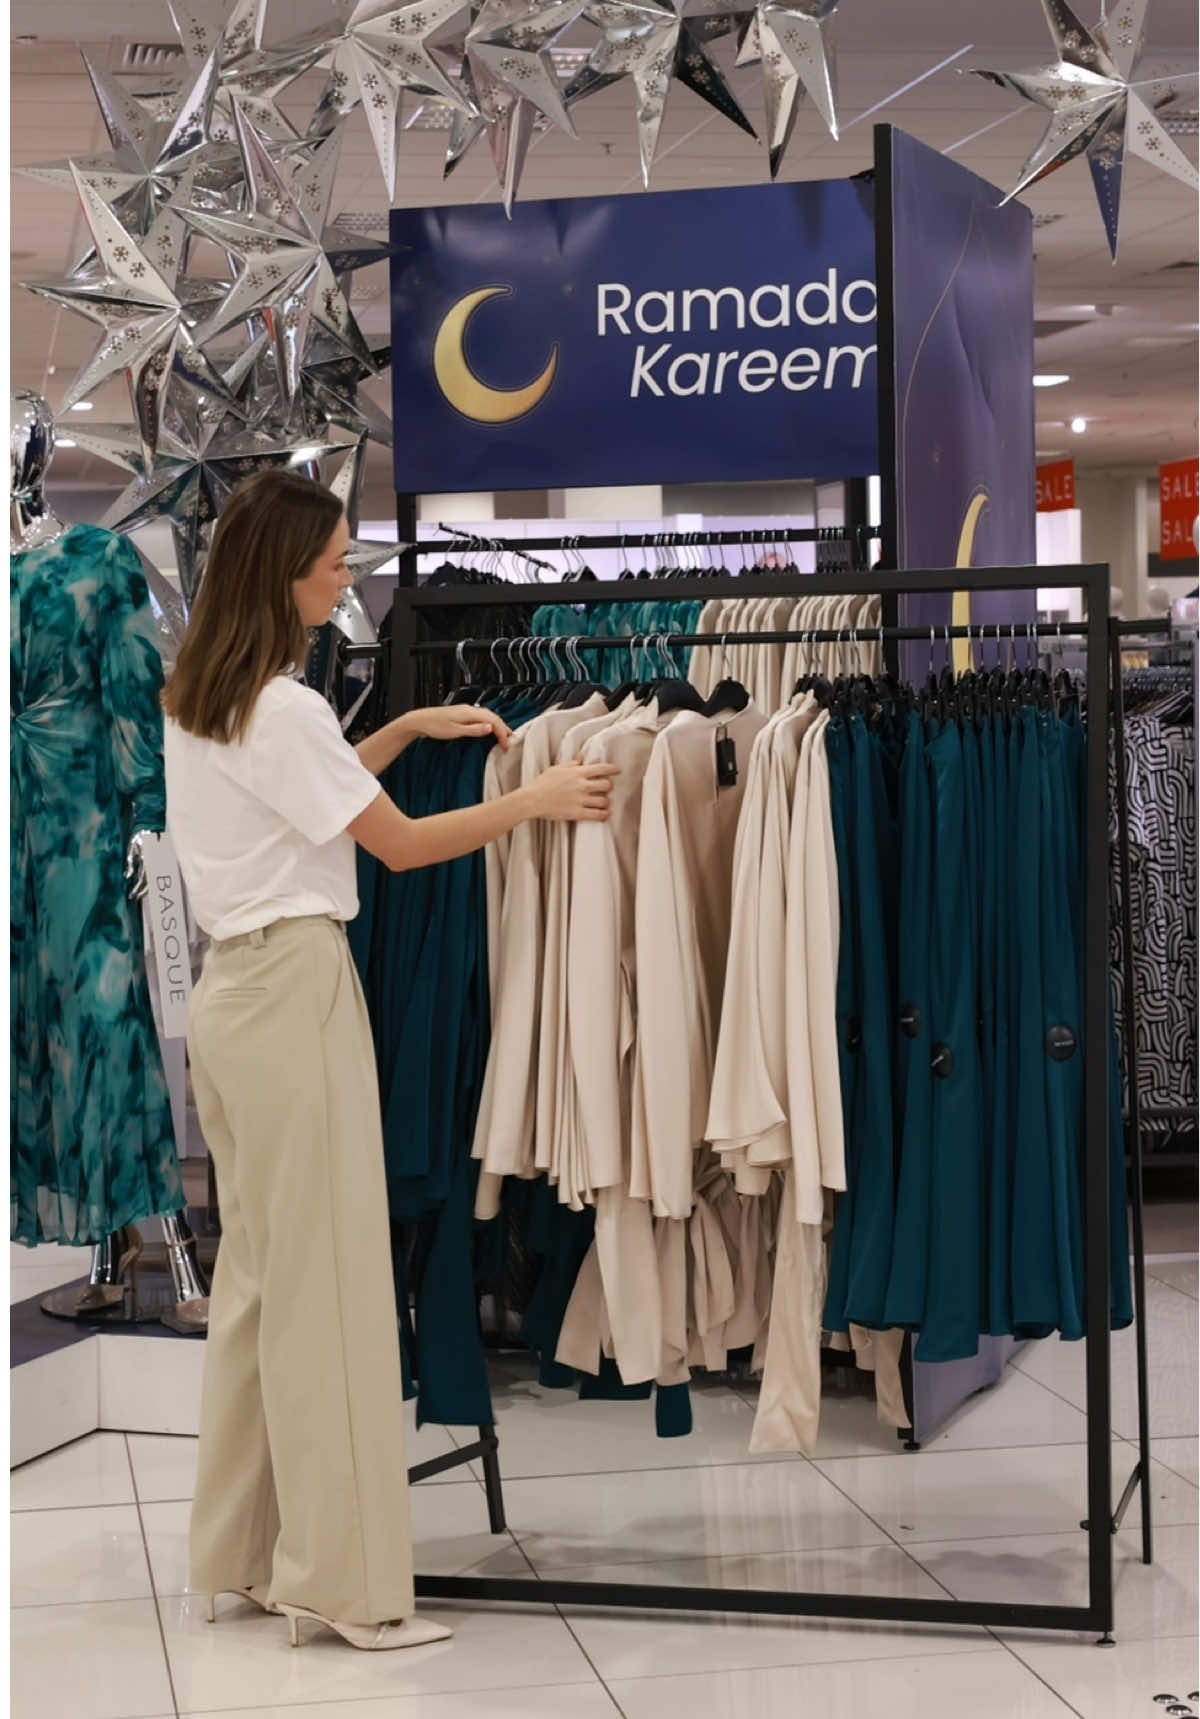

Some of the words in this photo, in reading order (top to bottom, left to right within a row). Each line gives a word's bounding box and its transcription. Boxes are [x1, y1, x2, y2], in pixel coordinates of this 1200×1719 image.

[597, 267, 877, 336] Ramada
[629, 343, 877, 398] Kareem
[1036, 475, 1072, 505] SALE
[1162, 519, 1193, 545] SAL
[156, 874, 187, 1005] BASQUE
